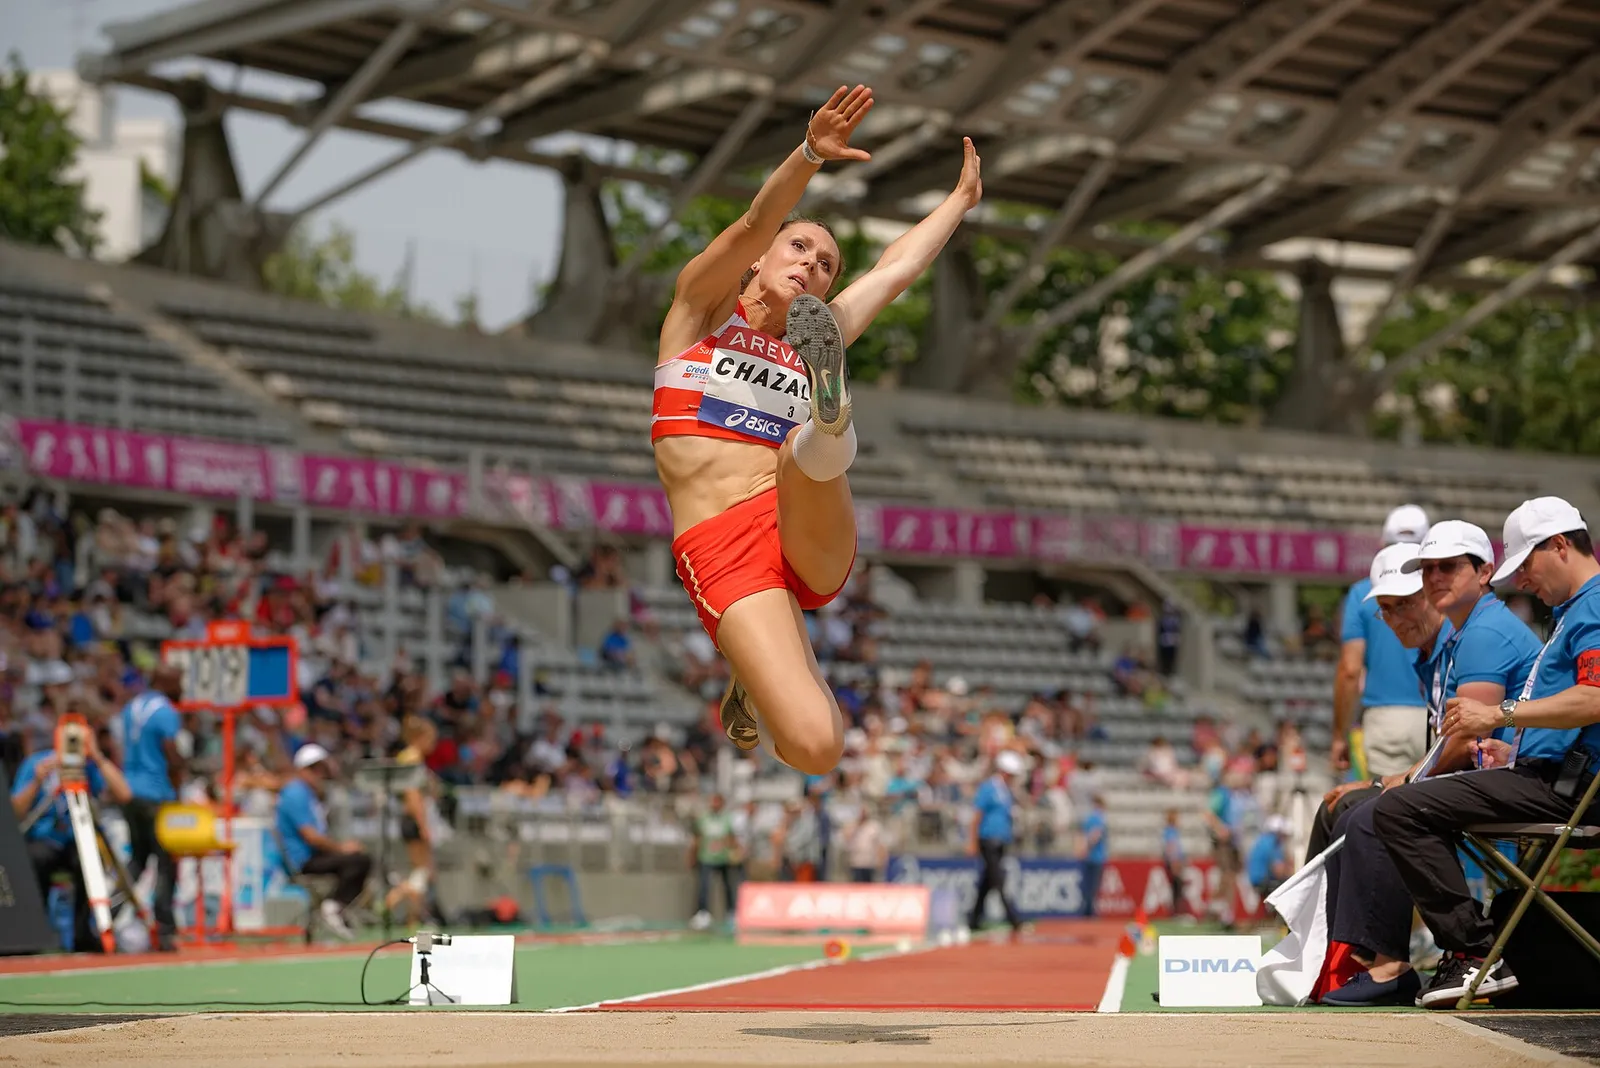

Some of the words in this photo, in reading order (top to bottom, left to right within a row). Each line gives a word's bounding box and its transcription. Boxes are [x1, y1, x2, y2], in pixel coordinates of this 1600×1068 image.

[728, 331, 806, 372] AREVA
[685, 364, 710, 375] Crédi
[715, 357, 809, 401] CHAZAL
[787, 406, 795, 418] 3
[745, 416, 782, 438] asics
[788, 891, 923, 920] AREVA
[1164, 958, 1257, 973] DIMA
